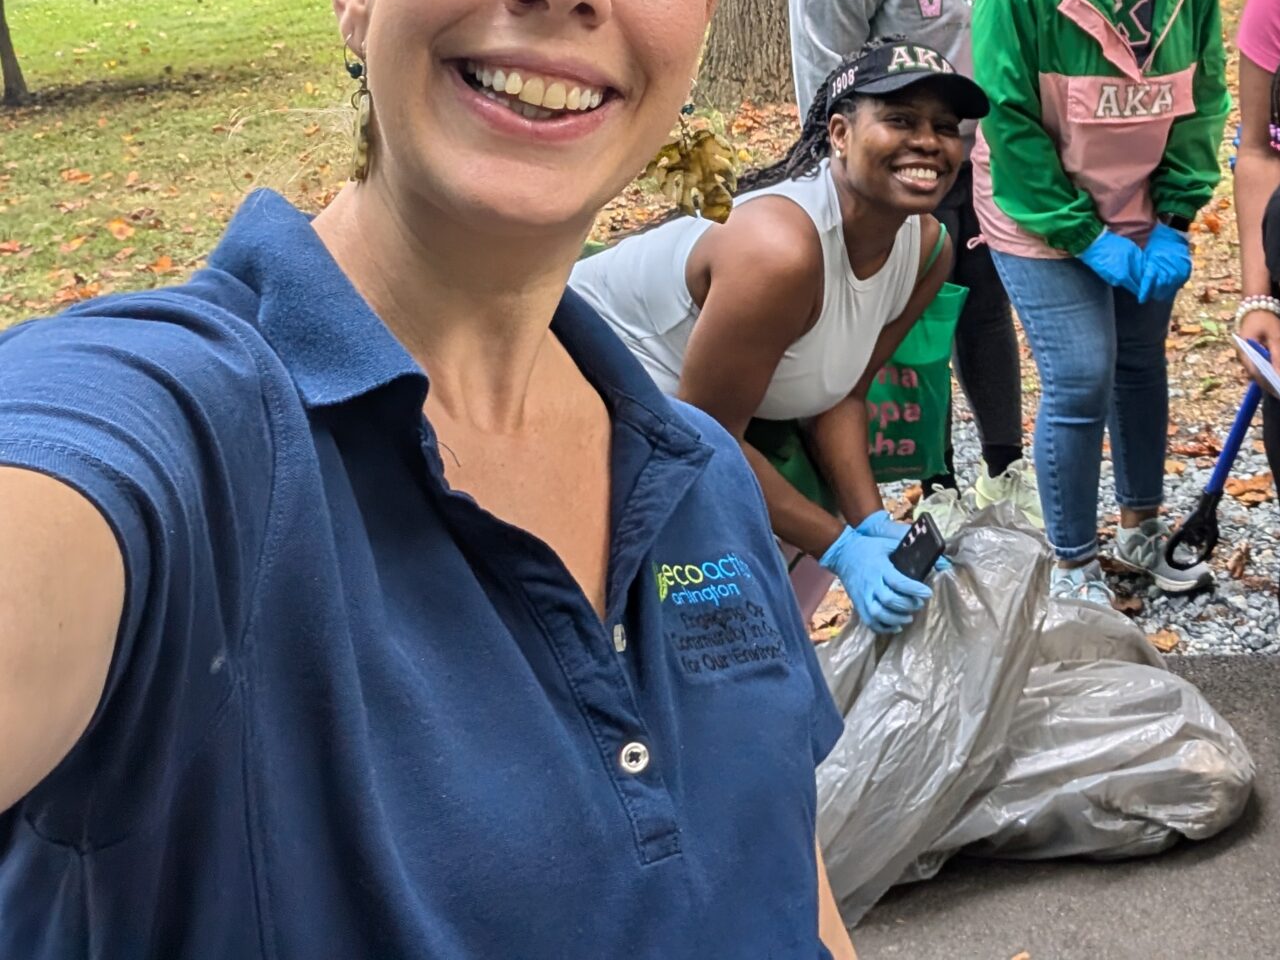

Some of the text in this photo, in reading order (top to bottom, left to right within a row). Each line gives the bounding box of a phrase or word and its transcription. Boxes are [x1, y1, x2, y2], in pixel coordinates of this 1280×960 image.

[886, 44, 956, 75] AKA
[831, 68, 857, 100] 1908
[1094, 82, 1174, 120] AKA
[671, 582, 741, 607] arlington
